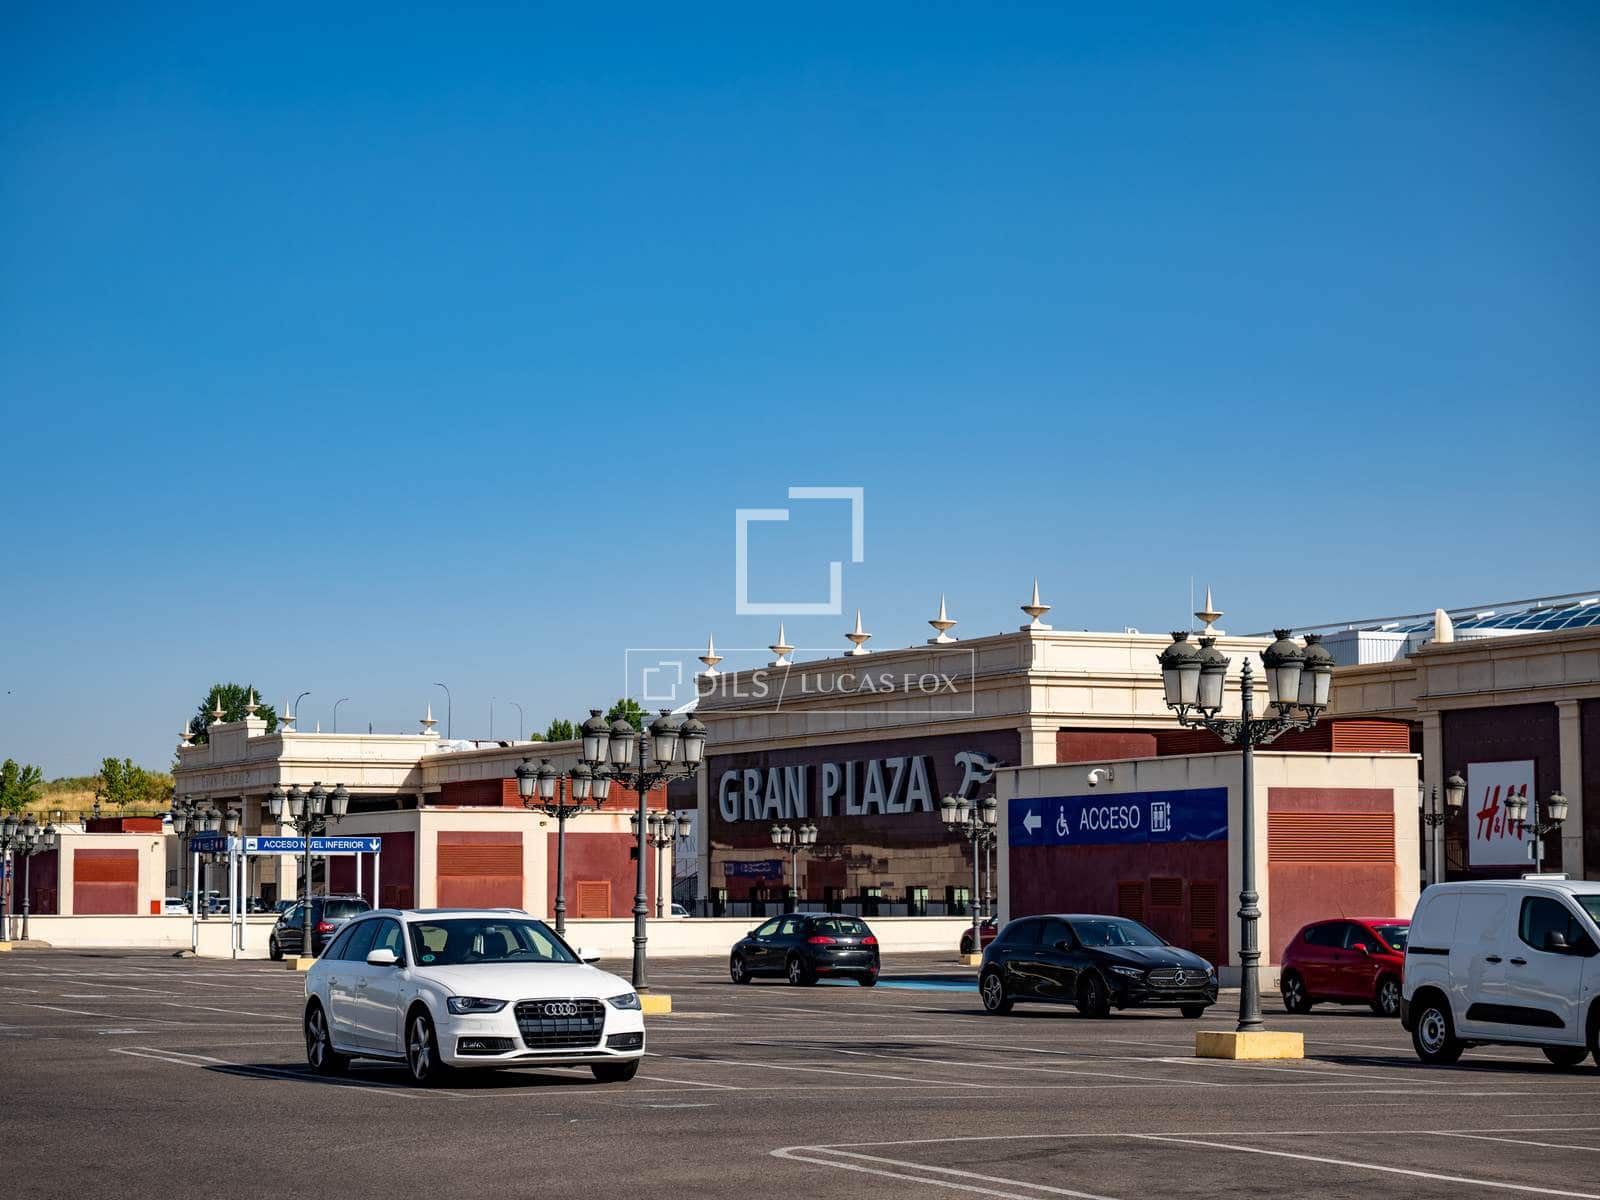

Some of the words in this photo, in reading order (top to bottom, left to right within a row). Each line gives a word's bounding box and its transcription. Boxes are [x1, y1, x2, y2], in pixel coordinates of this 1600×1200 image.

[718, 764, 809, 824] GRAN
[822, 755, 934, 818] PLAZA
[1079, 805, 1141, 830] ACCESO
[263, 840, 299, 849] ACCESO
[300, 840, 324, 849] NVEL
[325, 840, 364, 849] INFERIOR
